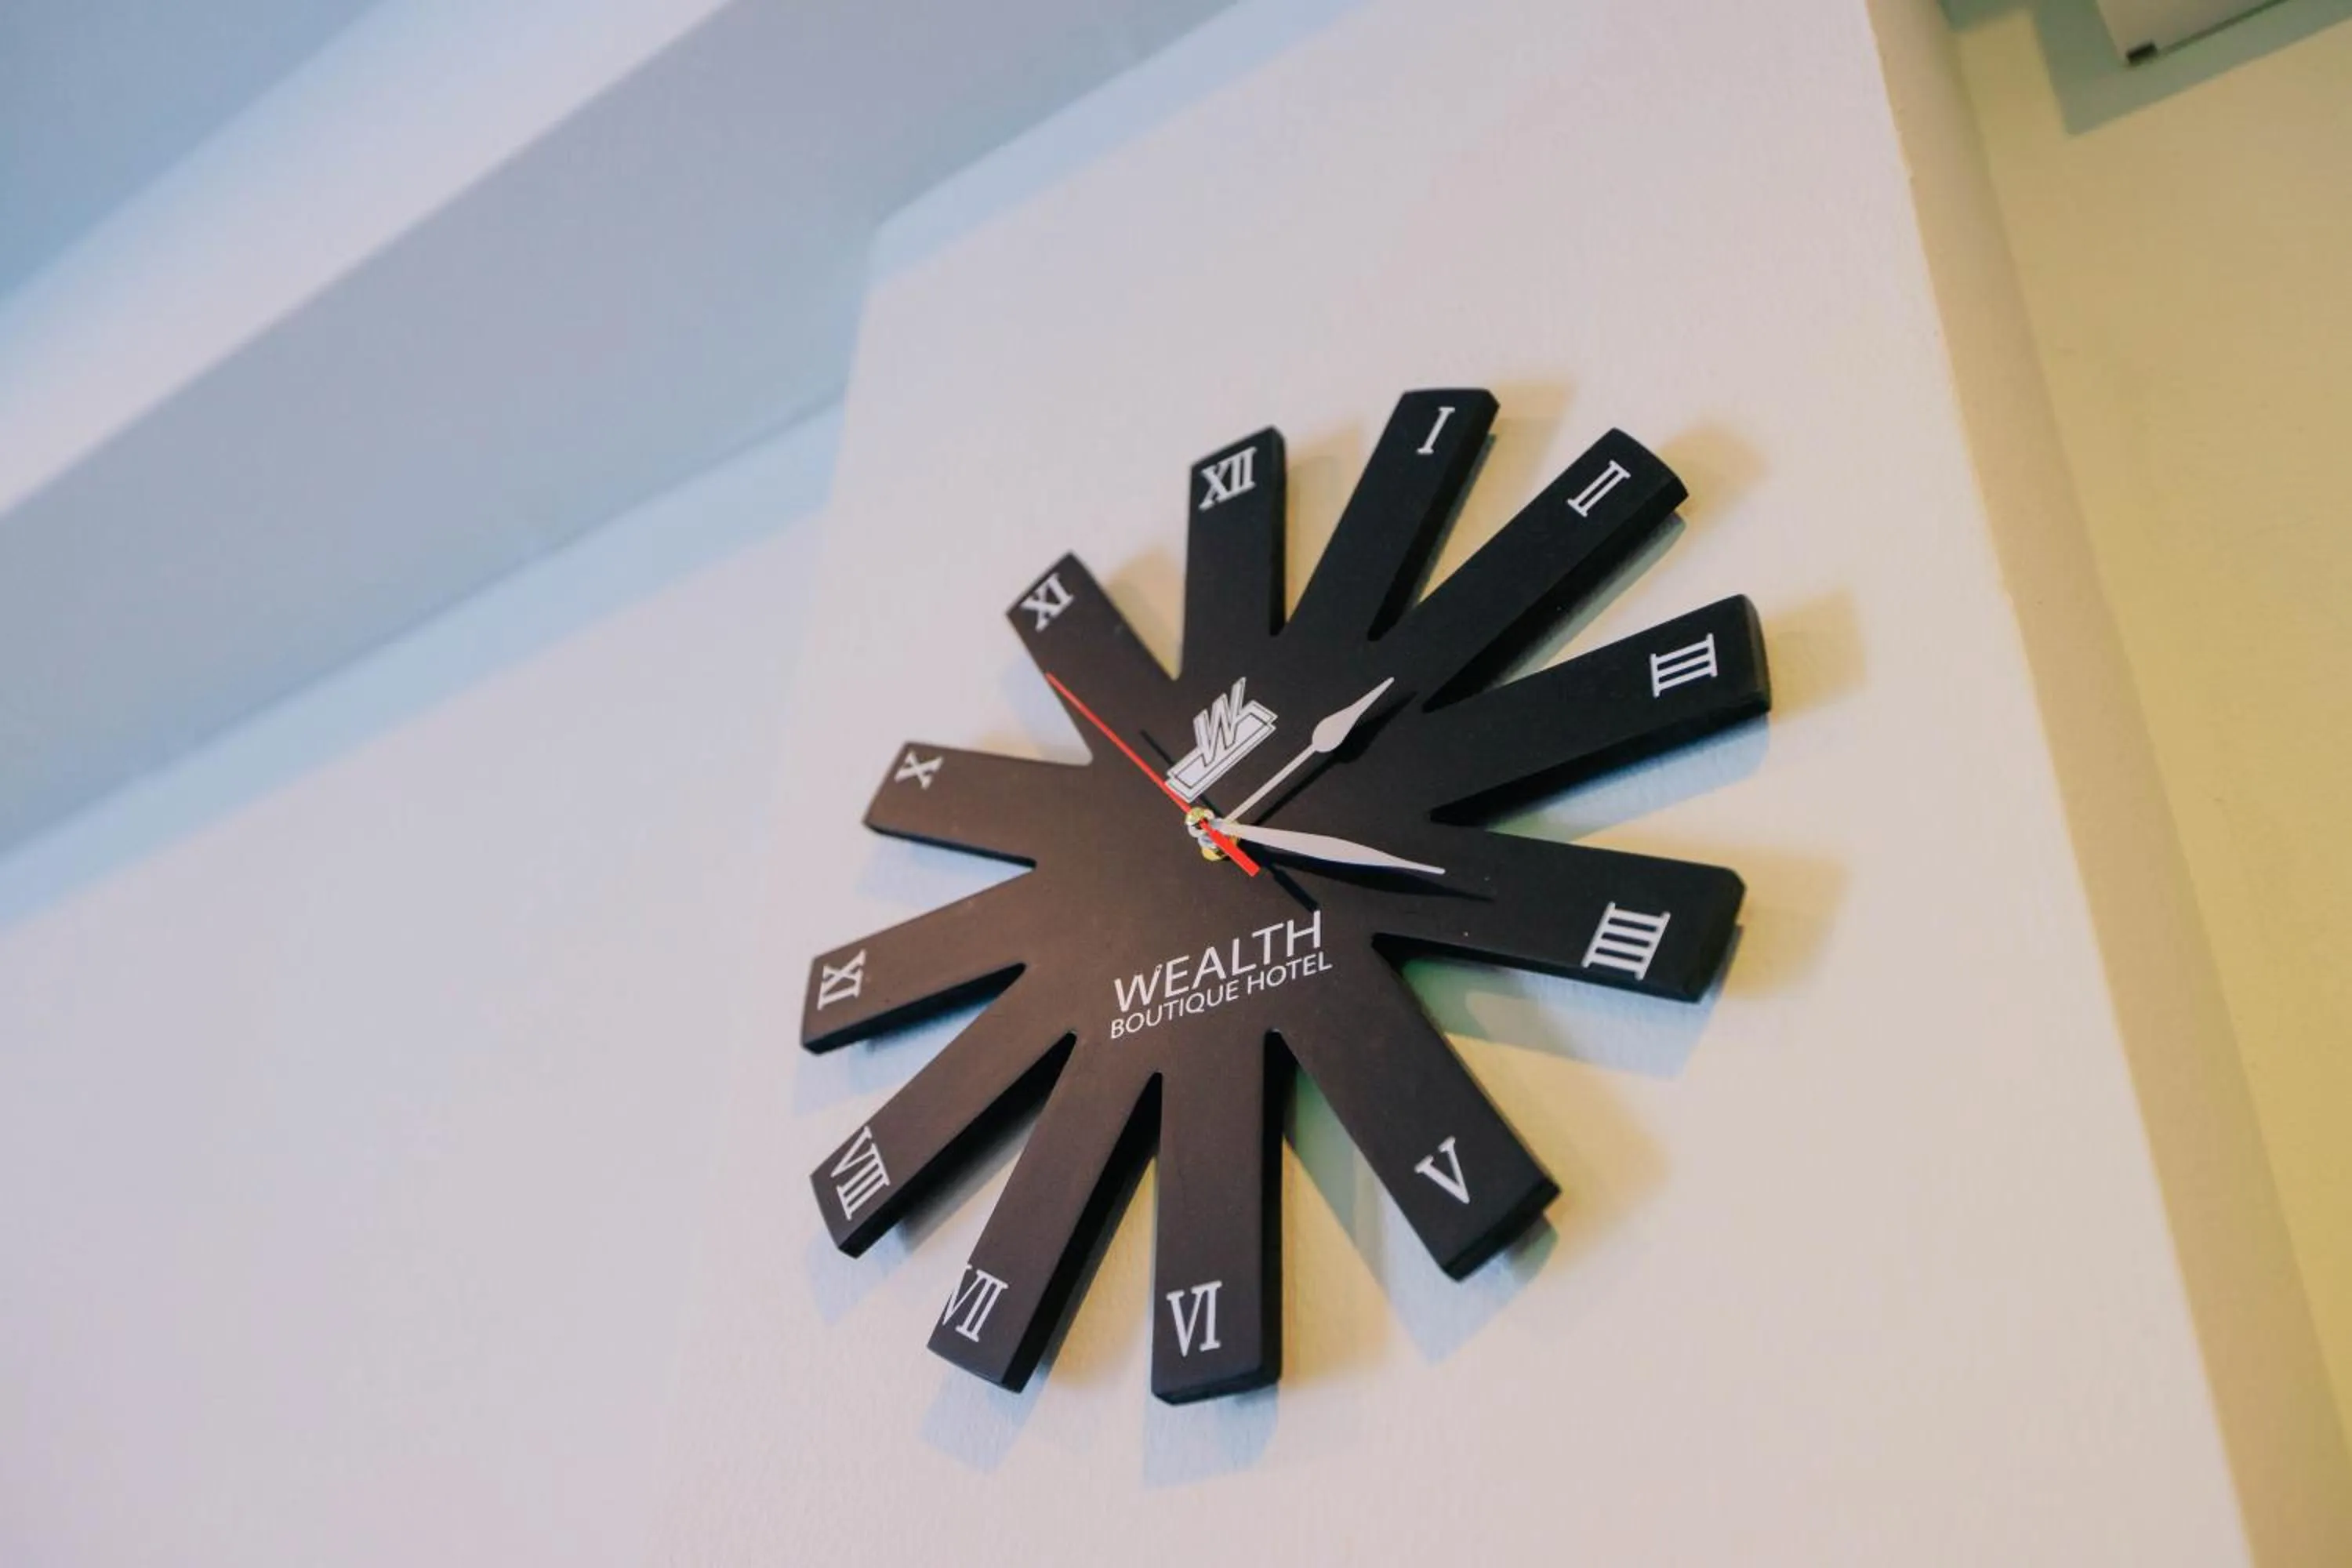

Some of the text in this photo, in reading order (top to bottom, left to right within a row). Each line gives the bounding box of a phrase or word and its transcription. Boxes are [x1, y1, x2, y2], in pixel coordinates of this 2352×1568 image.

[1417, 406, 1456, 455] I
[1199, 446, 1256, 510] XII
[1566, 459, 1632, 517] II
[1021, 573, 1073, 630] XI
[1650, 633, 1719, 698] III
[894, 751, 943, 789] X
[1113, 909, 1322, 1014] WEALTH
[1581, 902, 1671, 980] IIII
[816, 949, 867, 1011] IX
[1109, 950, 1334, 1040] BOUTIQUE HOTEL
[829, 1124, 891, 1221] VIII
[1414, 1137, 1471, 1204] V
[1165, 1279, 1223, 1357] VI
